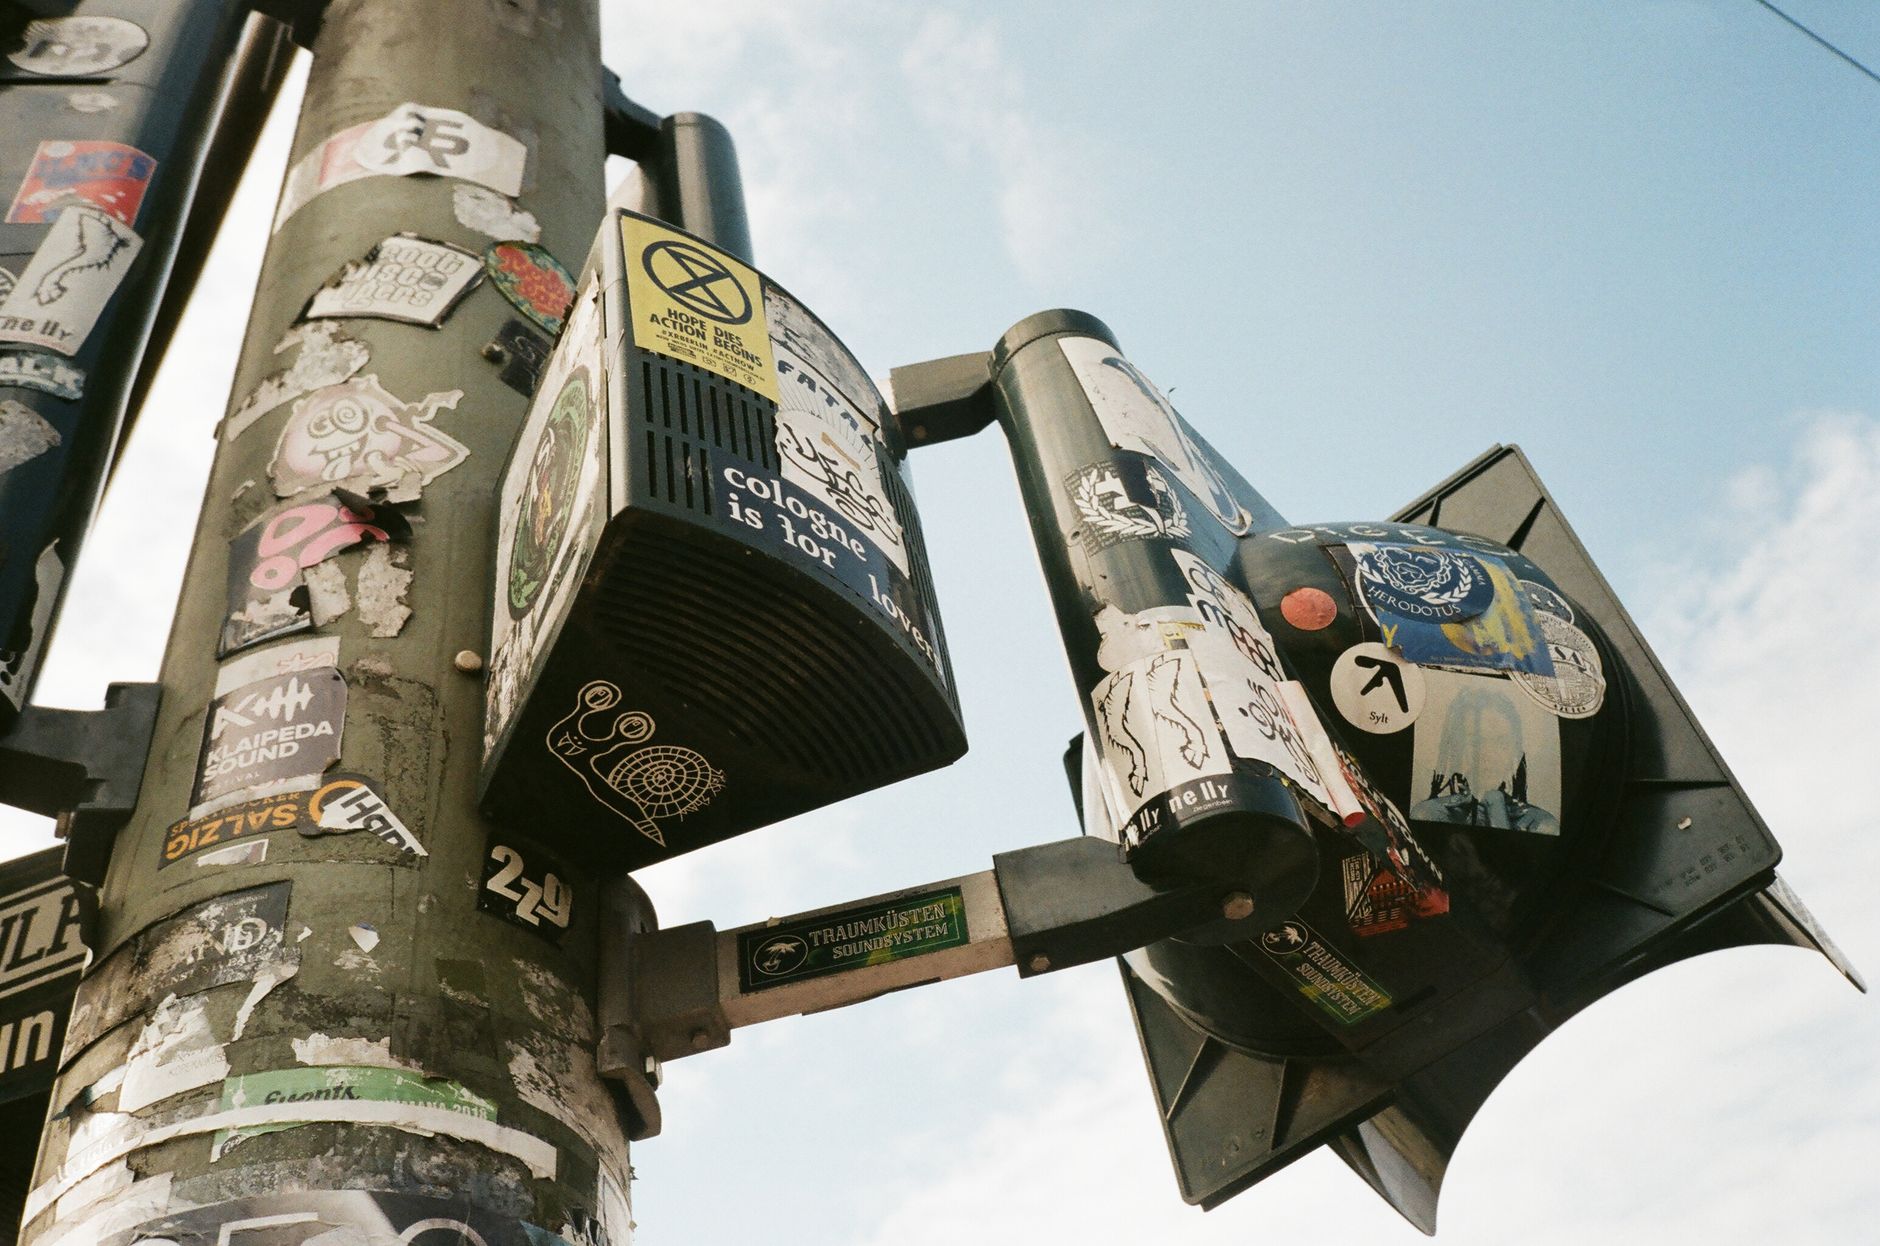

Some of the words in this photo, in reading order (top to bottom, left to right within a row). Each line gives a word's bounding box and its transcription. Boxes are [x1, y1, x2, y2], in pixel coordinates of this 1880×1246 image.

[649, 313, 707, 341] ACTION
[713, 335, 763, 368] BEGINS
[667, 308, 707, 331] HOPE
[713, 325, 744, 347] DIES
[713, 348, 755, 371] #ACTNOW
[723, 467, 867, 562] cologne
[728, 492, 764, 530] is
[777, 513, 837, 569] for
[1367, 586, 1462, 617] HERODOTUS
[1370, 711, 1388, 725] Sylt
[203, 741, 300, 783] SOUND
[206, 720, 335, 767] KLAIPEDA
[165, 803, 299, 860] SALZIG
[808, 902, 946, 948] TRAUMKÜSTEN
[831, 922, 949, 960] SOUNDSYSTEM
[1296, 962, 1361, 1015] SOUNDSYSTEM
[1302, 940, 1381, 1006] TRAUMKÜSTEN
